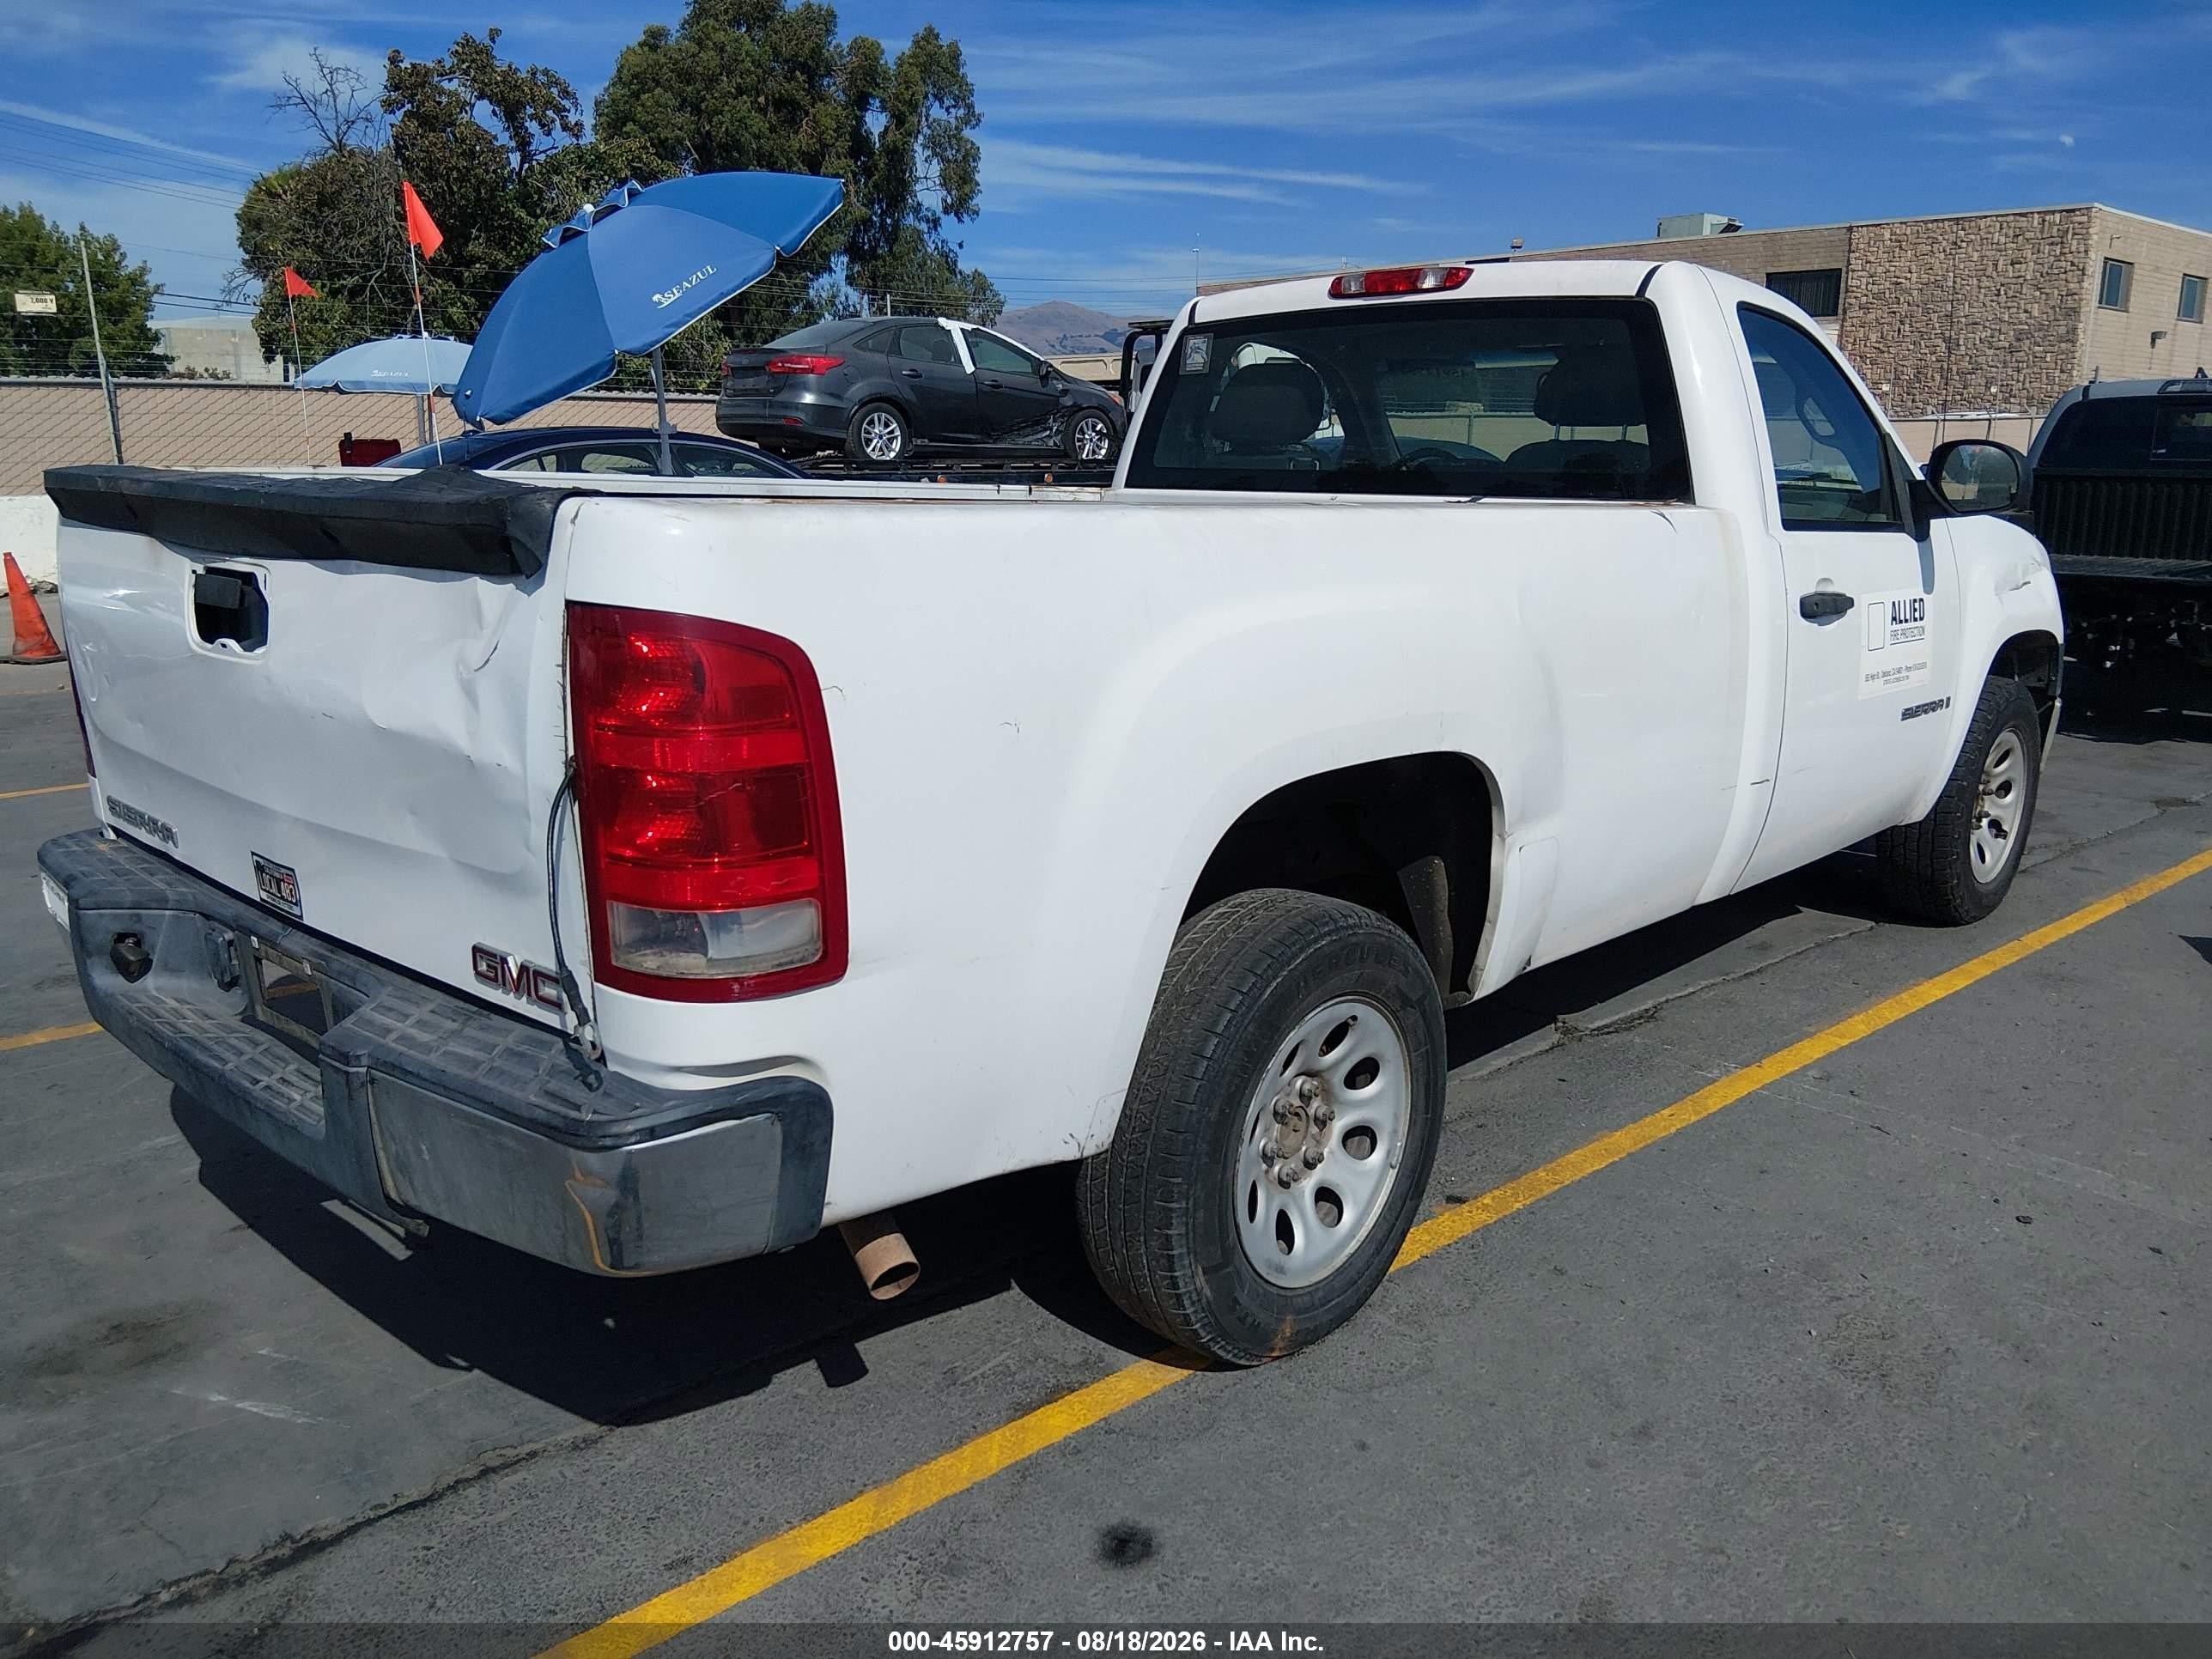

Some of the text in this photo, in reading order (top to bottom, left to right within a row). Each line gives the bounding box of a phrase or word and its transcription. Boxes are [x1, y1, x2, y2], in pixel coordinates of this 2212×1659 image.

[664, 264, 717, 301] SEAZUL
[1891, 598, 1925, 626] ALLIED
[1900, 698, 1945, 722] SIERRA
[106, 795, 179, 849] SIERRA
[258, 870, 282, 897] LOCAL
[280, 880, 296, 903] 483
[471, 942, 567, 1014] GMC
